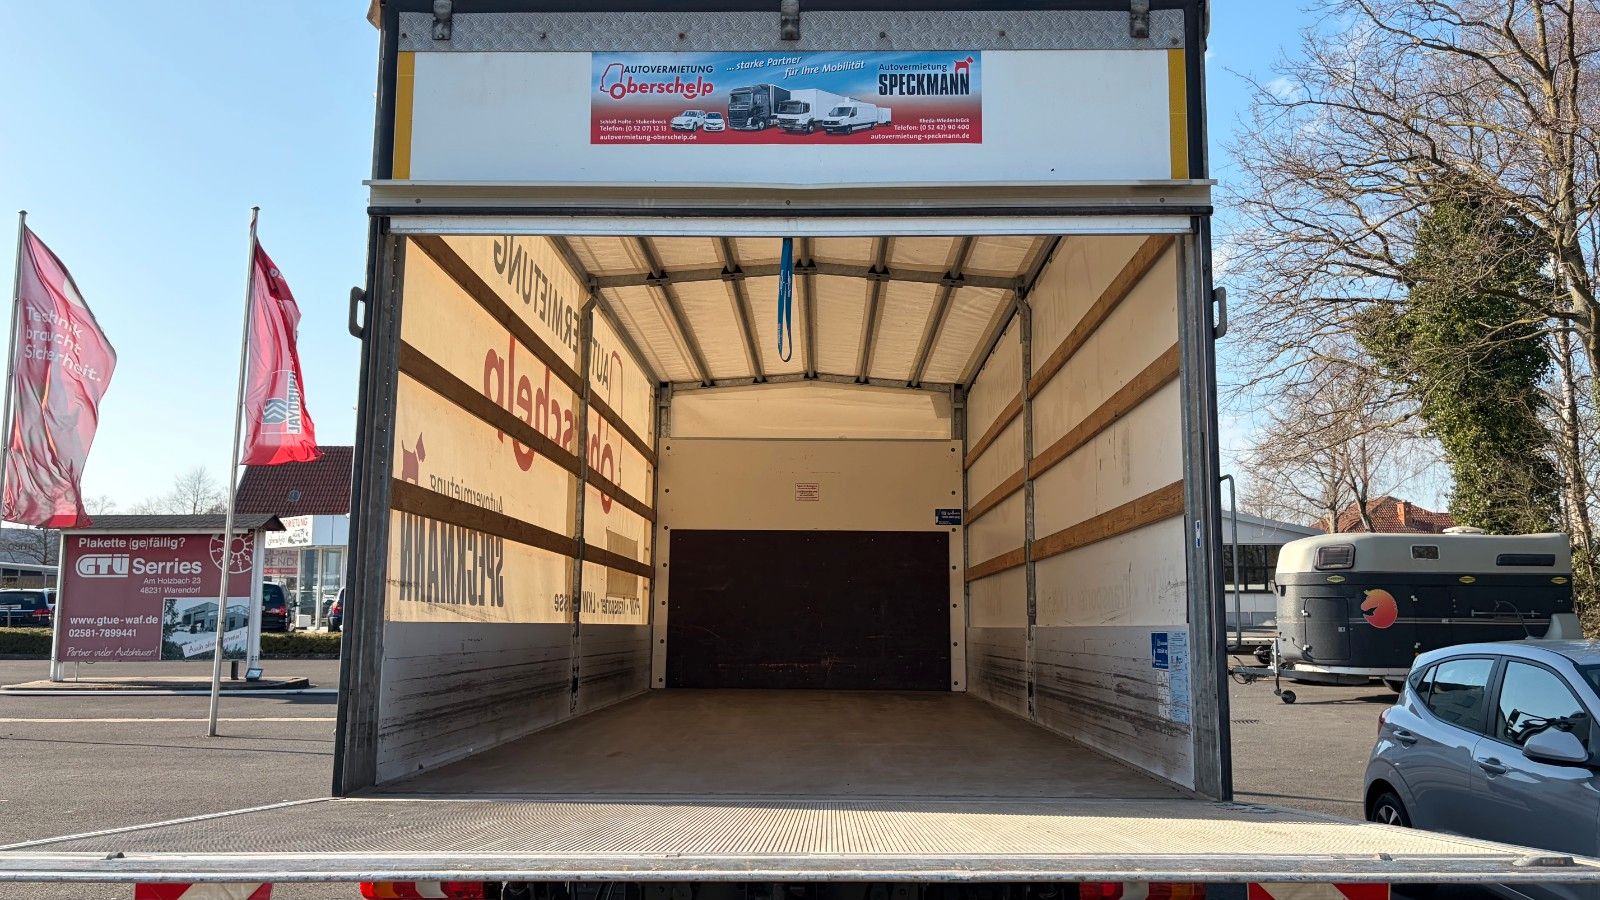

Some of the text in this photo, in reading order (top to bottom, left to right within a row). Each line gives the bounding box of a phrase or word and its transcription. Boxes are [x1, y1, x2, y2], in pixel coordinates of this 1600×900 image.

[767, 56, 802, 66] Partner
[623, 65, 714, 74] AUTOVERMIETUNG
[784, 60, 866, 80] für Ihre Mobilität
[878, 63, 948, 73] Autovermietung
[609, 76, 714, 99] Oberschelp
[878, 73, 970, 96] SPECKMANN
[599, 134, 697, 142] autovermietung-oberschelp.de
[870, 132, 970, 140] autovermietung-speckmann.de
[26, 306, 83, 339] Technik
[26, 325, 82, 356] braucht
[78, 537, 186, 550] Plakette (ge)fällig?
[77, 554, 202, 577] GTÜ Serries
[143, 577, 202, 585] Am Holzbach 23
[140, 586, 201, 594] 48231 Warendorf
[68, 628, 137, 638] 02581-7899441
[66, 646, 93, 658] Partner
